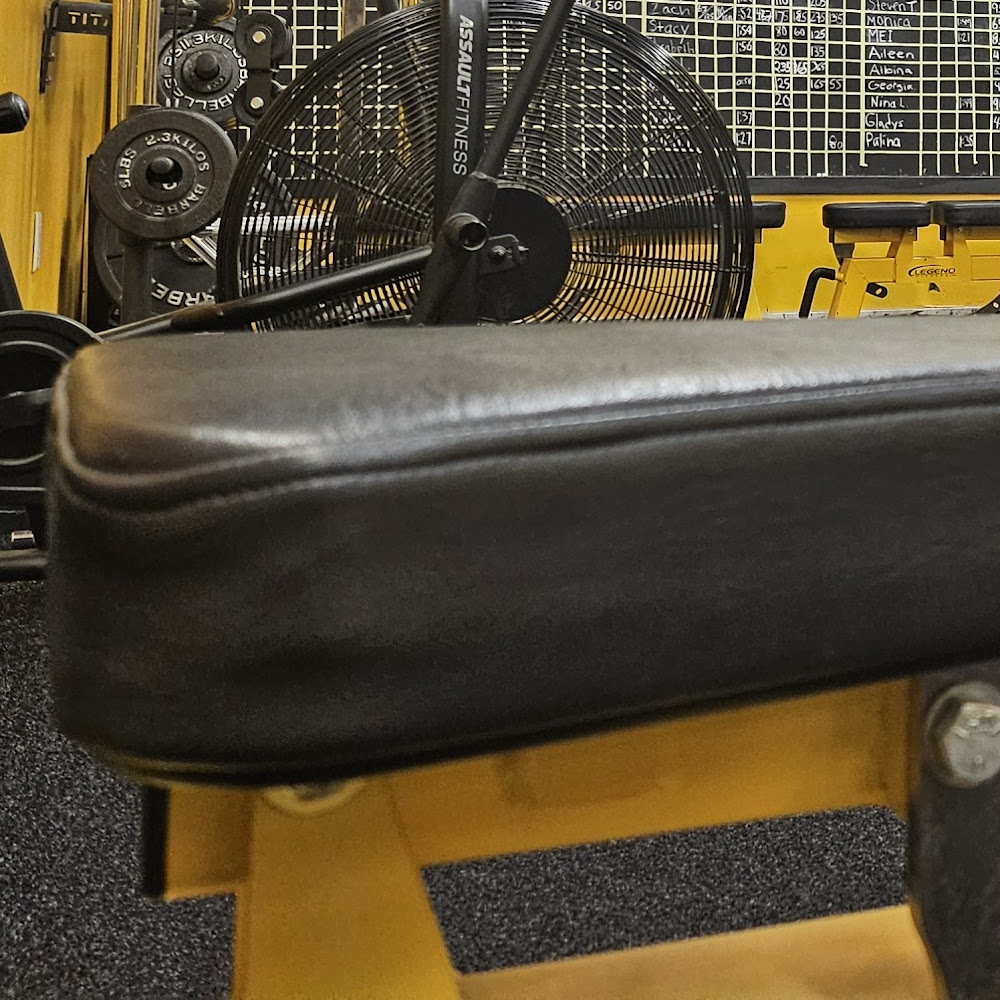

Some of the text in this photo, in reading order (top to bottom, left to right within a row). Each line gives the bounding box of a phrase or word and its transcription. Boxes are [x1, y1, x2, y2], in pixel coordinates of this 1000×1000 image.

[650, 20, 690, 44] Stacy
[867, 30, 893, 43] MEI
[868, 46, 915, 60] Aileen
[869, 63, 913, 76] Albina
[871, 96, 897, 108] Nina
[865, 113, 904, 129] Gladys
[865, 132, 901, 148] Palina
[145, 132, 210, 172] 2.3KILOS
[136, 184, 207, 216] BARBELL
[914, 267, 956, 275] LEGEND
[151, 277, 217, 307] ARBE
